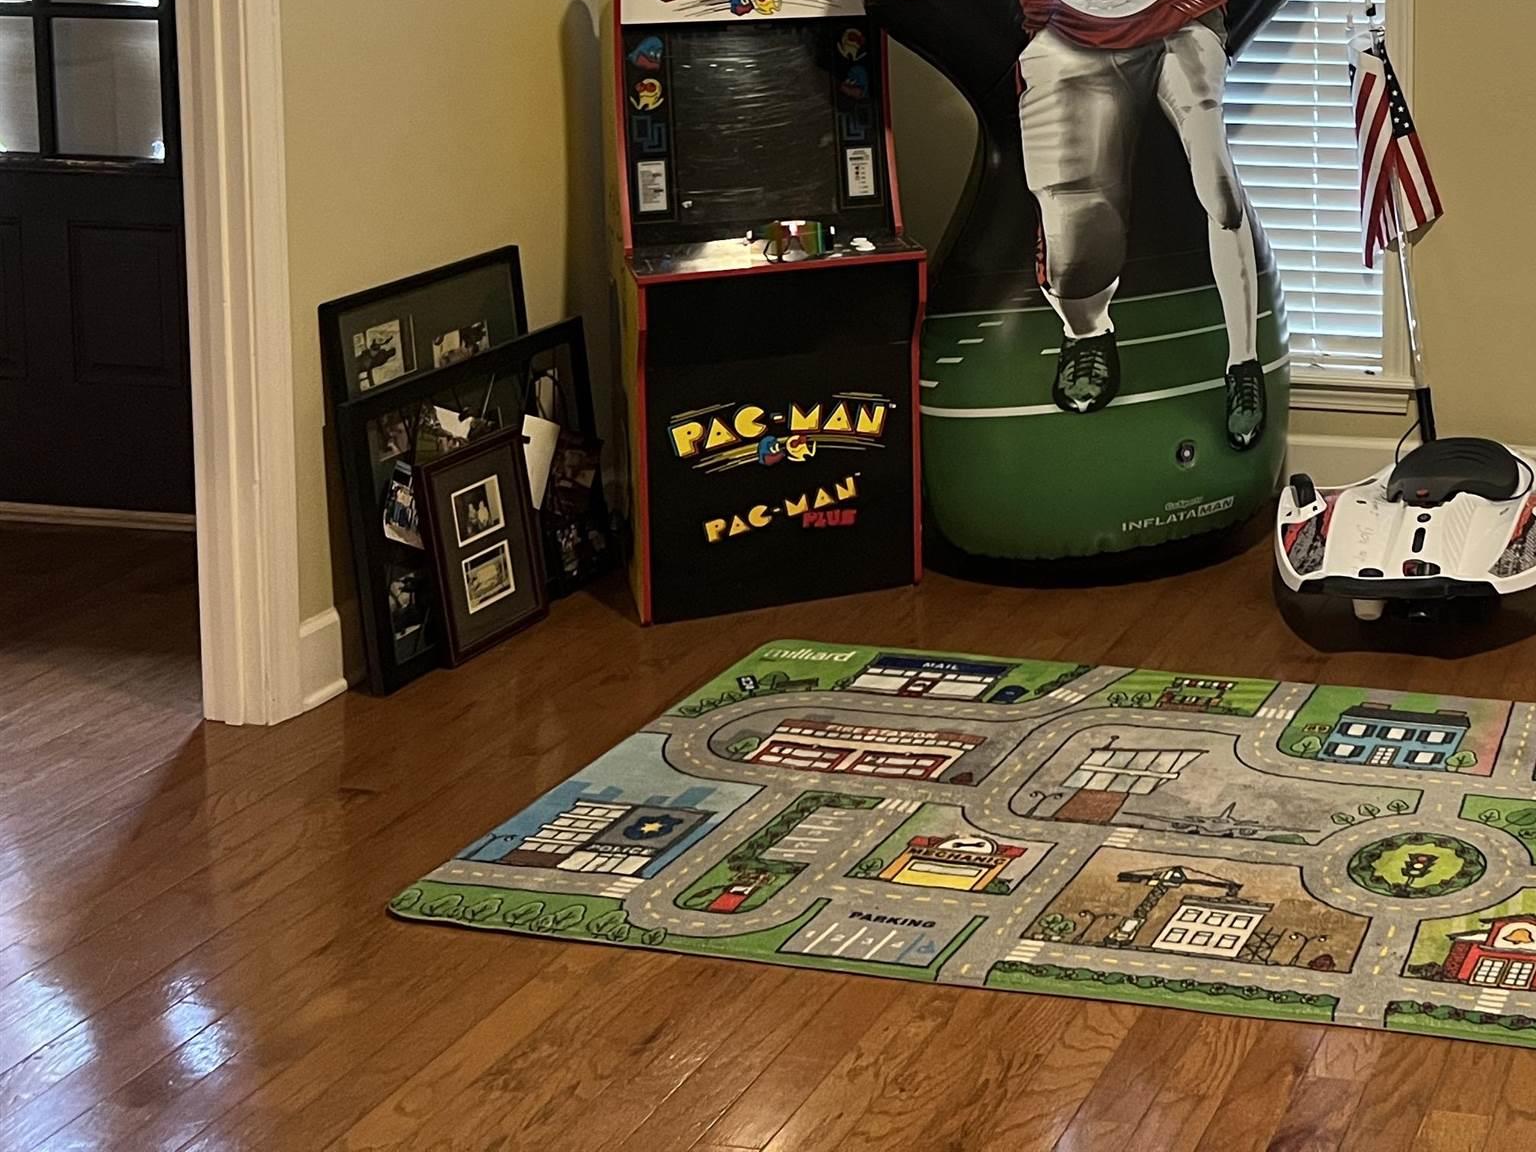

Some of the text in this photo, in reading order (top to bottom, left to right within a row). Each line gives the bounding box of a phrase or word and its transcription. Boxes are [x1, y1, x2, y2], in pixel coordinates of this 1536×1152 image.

[669, 402, 887, 458] PAC-MAN
[704, 476, 857, 543] PAC-MAN
[802, 509, 858, 528] PLUS
[764, 648, 857, 662] milliard
[922, 662, 959, 671] MAIL
[826, 724, 940, 739] FIRE STATION
[586, 844, 657, 856] POLICE
[907, 848, 1006, 865] MECHANIC
[849, 911, 936, 929] PARKING
